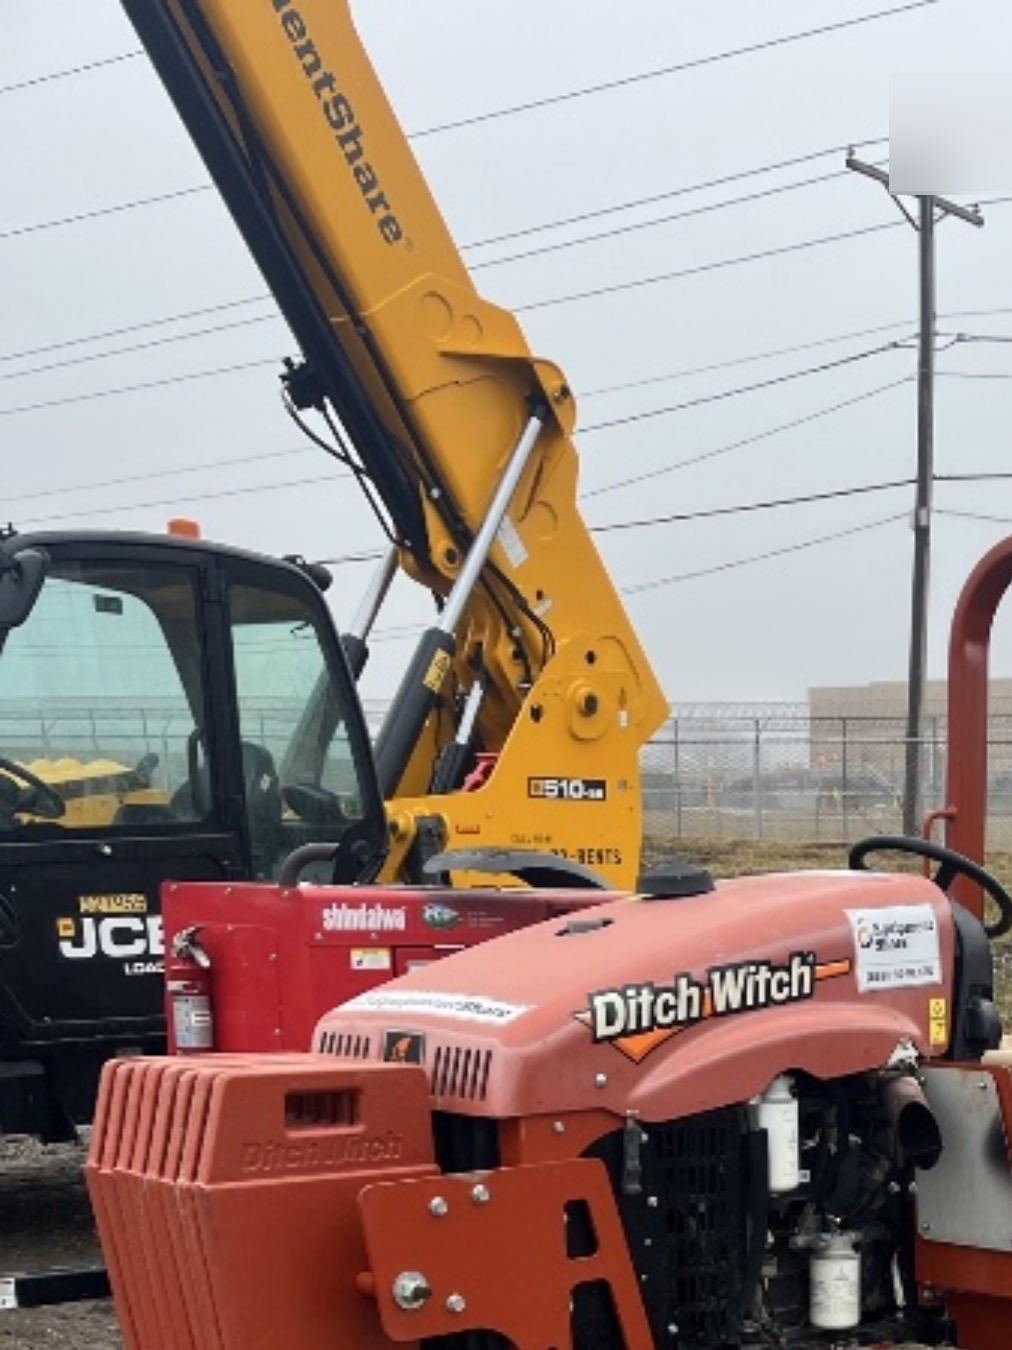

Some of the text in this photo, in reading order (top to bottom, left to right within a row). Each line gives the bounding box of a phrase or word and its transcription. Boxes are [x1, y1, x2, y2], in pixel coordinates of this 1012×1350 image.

[272, 0, 404, 246] entShare
[593, 955, 812, 1039] Ditch Witch
